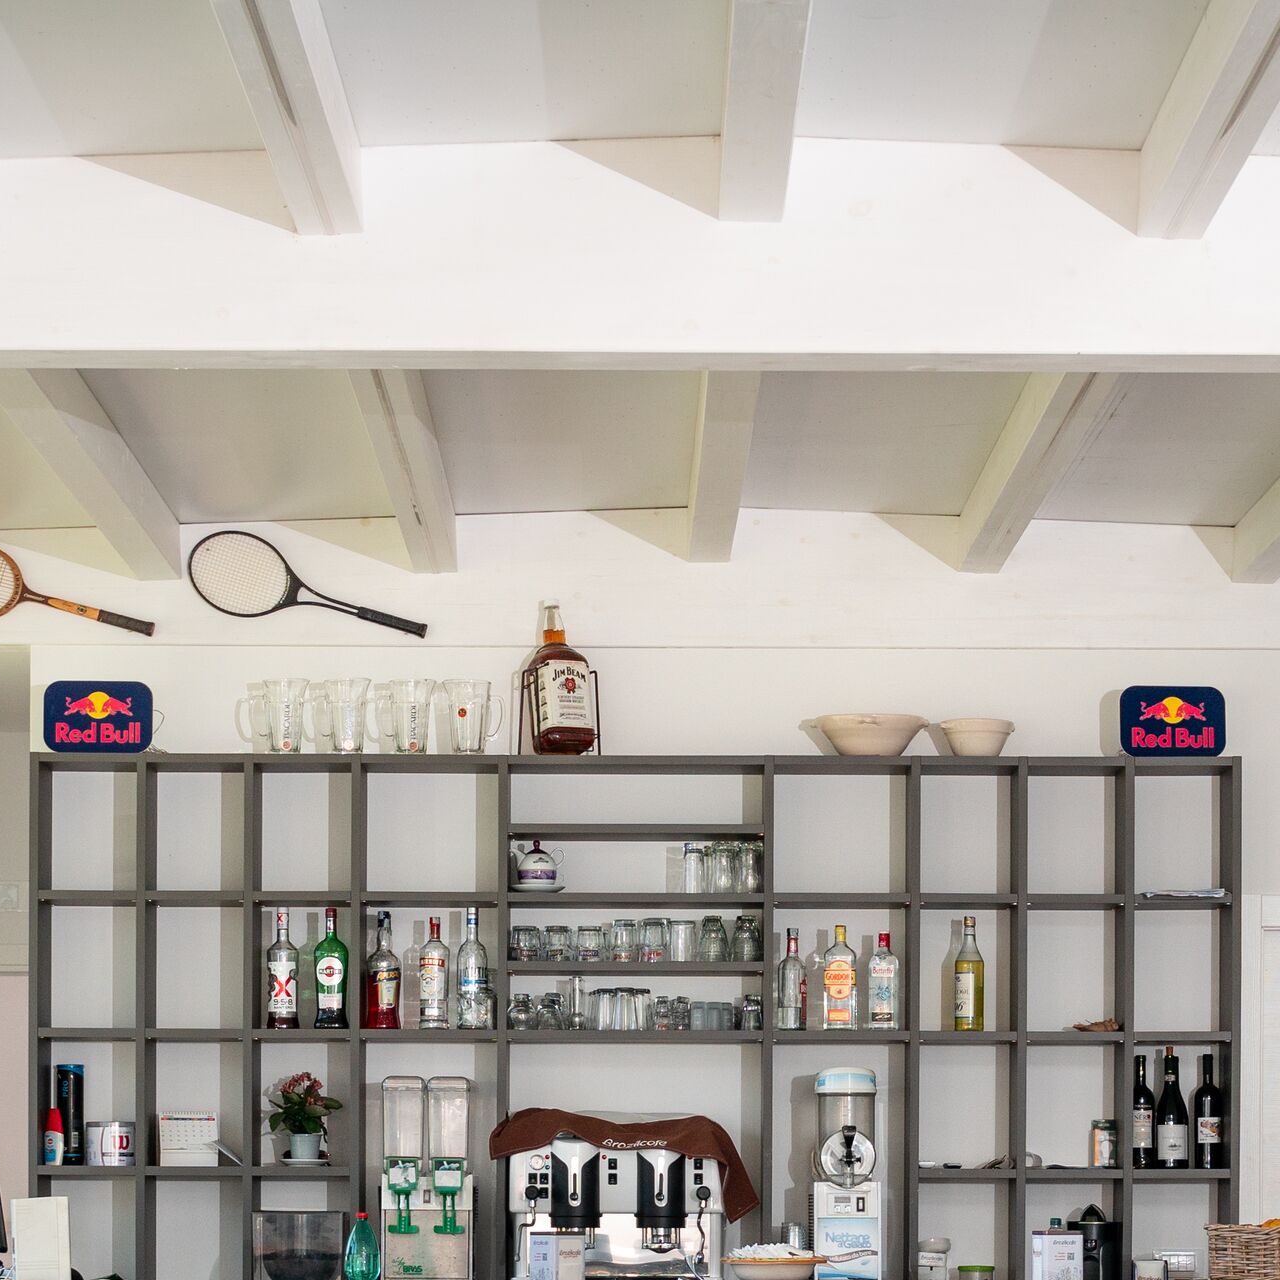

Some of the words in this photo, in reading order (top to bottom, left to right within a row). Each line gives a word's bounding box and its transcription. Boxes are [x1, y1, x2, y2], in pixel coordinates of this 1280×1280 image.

[552, 668, 566, 682] JIM
[566, 666, 587, 683] BEAM
[55, 722, 97, 743] Red
[100, 722, 141, 744] Bull
[1131, 727, 1172, 748] Red
[1175, 727, 1215, 748] Bull
